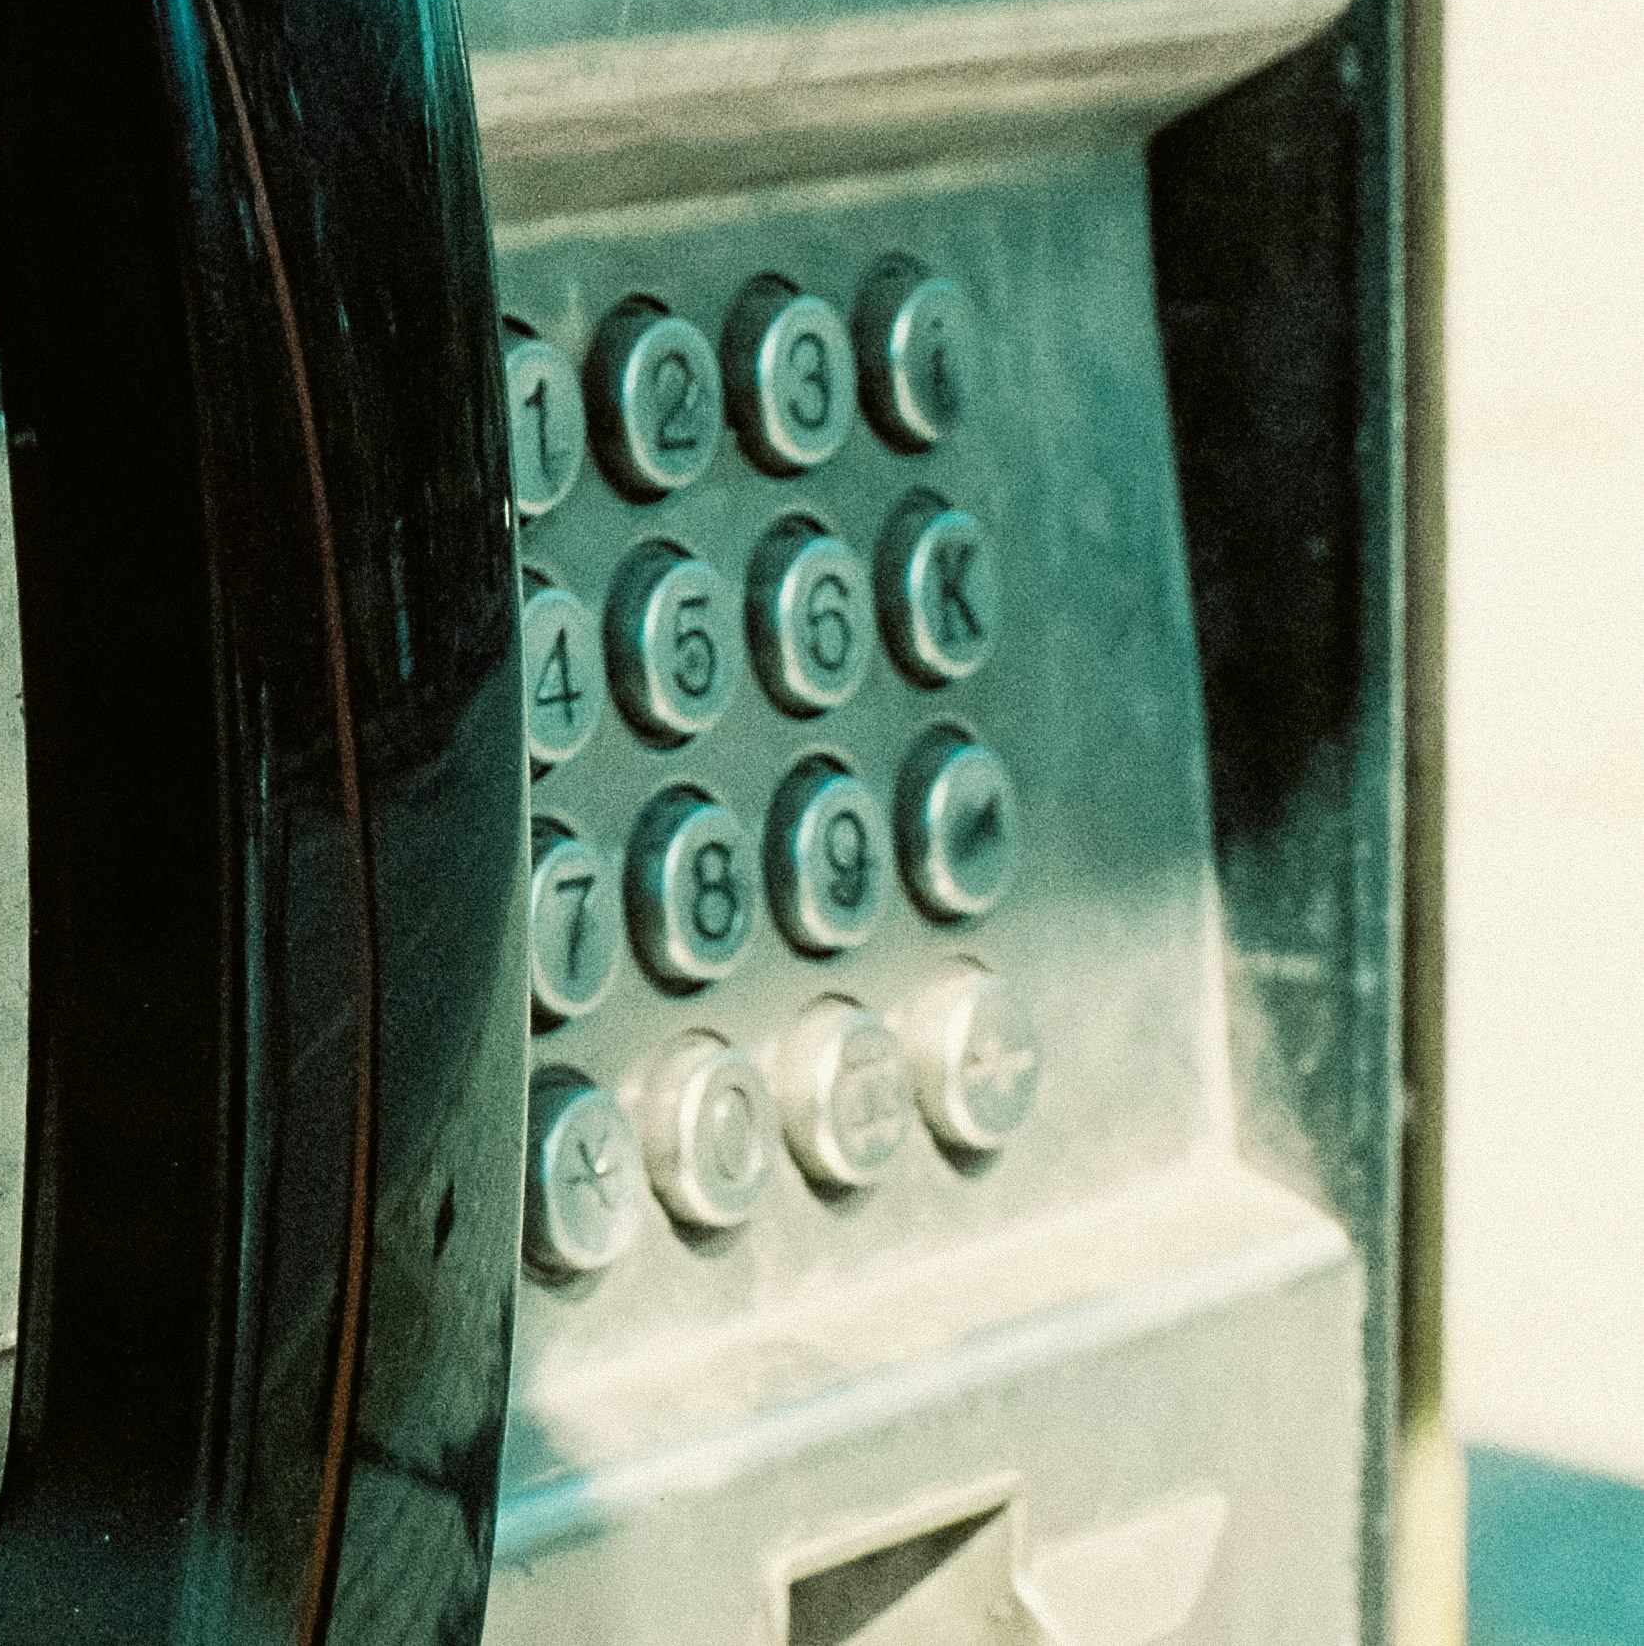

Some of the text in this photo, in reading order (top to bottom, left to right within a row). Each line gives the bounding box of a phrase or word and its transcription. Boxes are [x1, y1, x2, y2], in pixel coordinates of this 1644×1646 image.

[523, 378, 553, 480] 1
[652, 352, 697, 451] 2
[788, 332, 830, 429] 3
[536, 544, 983, 725] 4 5 6 K
[556, 811, 868, 981] 7 8 9
